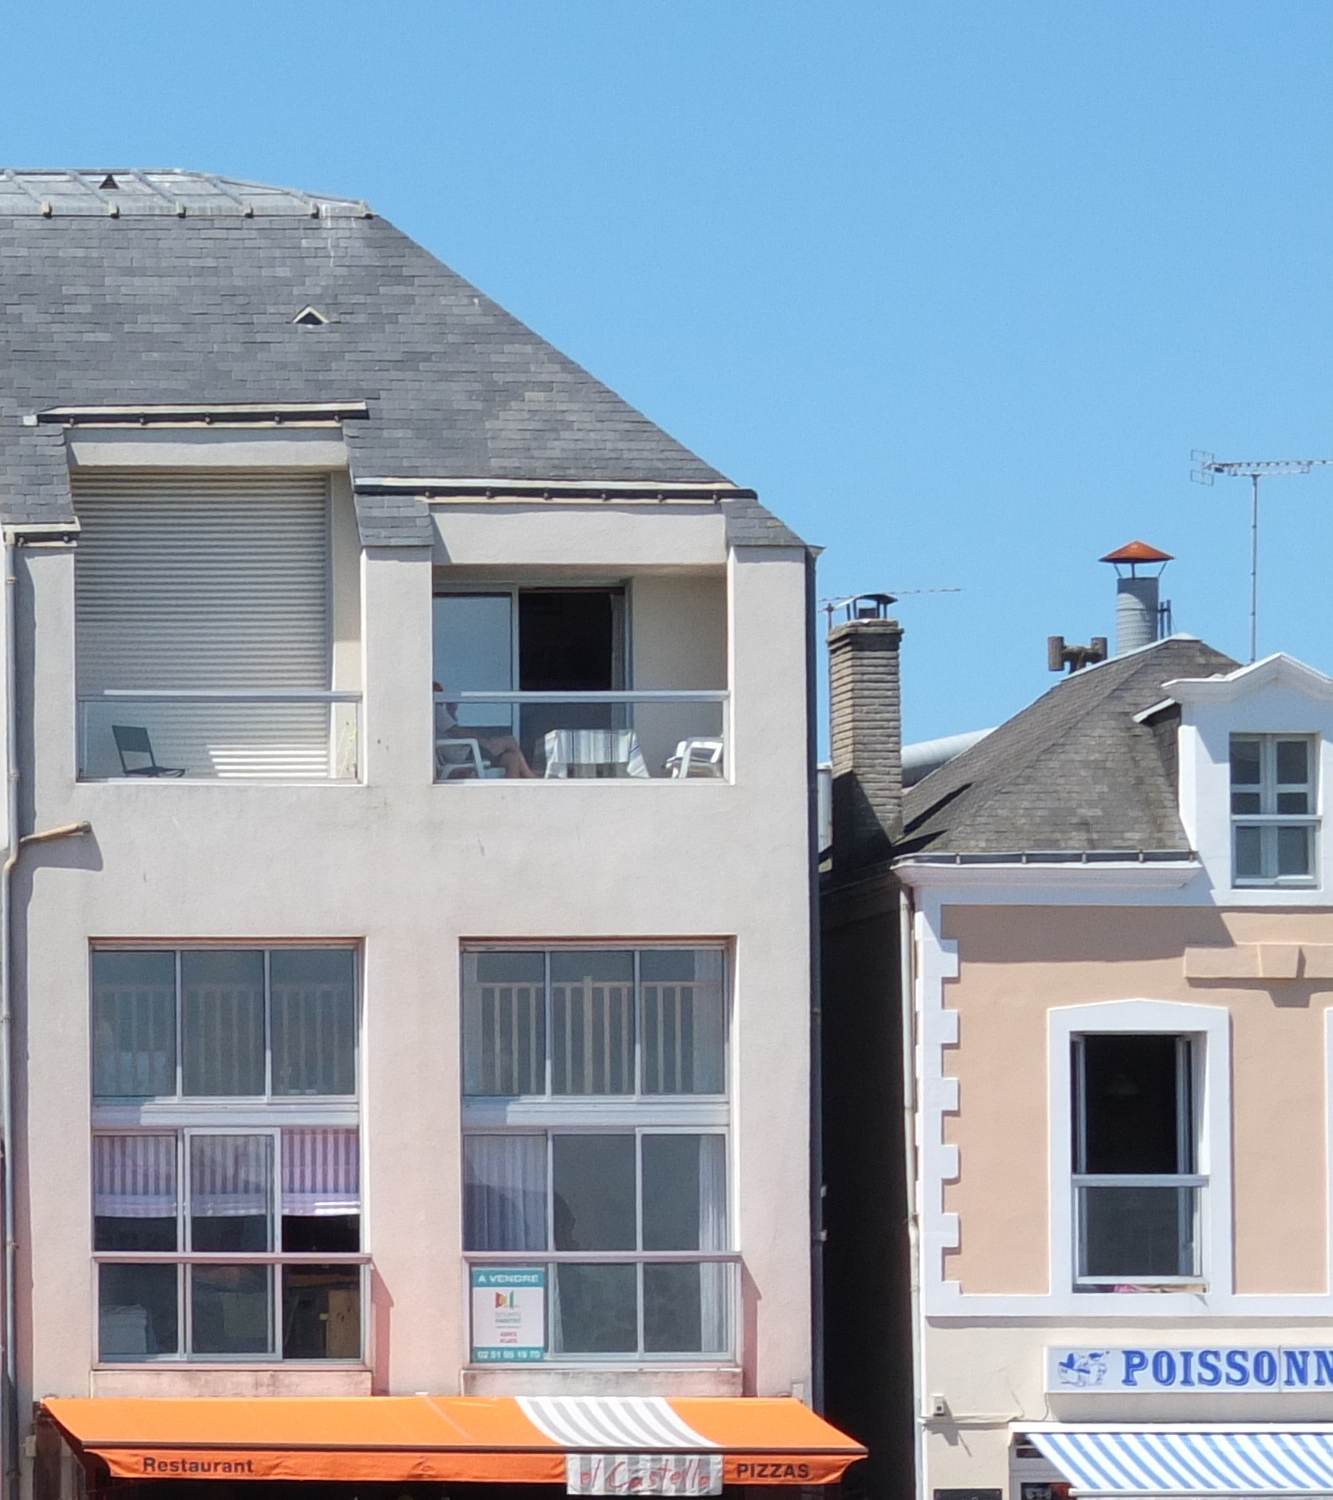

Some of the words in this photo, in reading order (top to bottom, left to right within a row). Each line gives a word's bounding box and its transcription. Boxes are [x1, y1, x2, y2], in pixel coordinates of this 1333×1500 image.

[478, 1274, 487, 1283] A
[489, 1274, 539, 1283] VENDRE
[1121, 1349, 1333, 1387] POISSONN
[142, 1456, 255, 1473] Restaurant
[736, 1463, 810, 1479] PIZZAS
